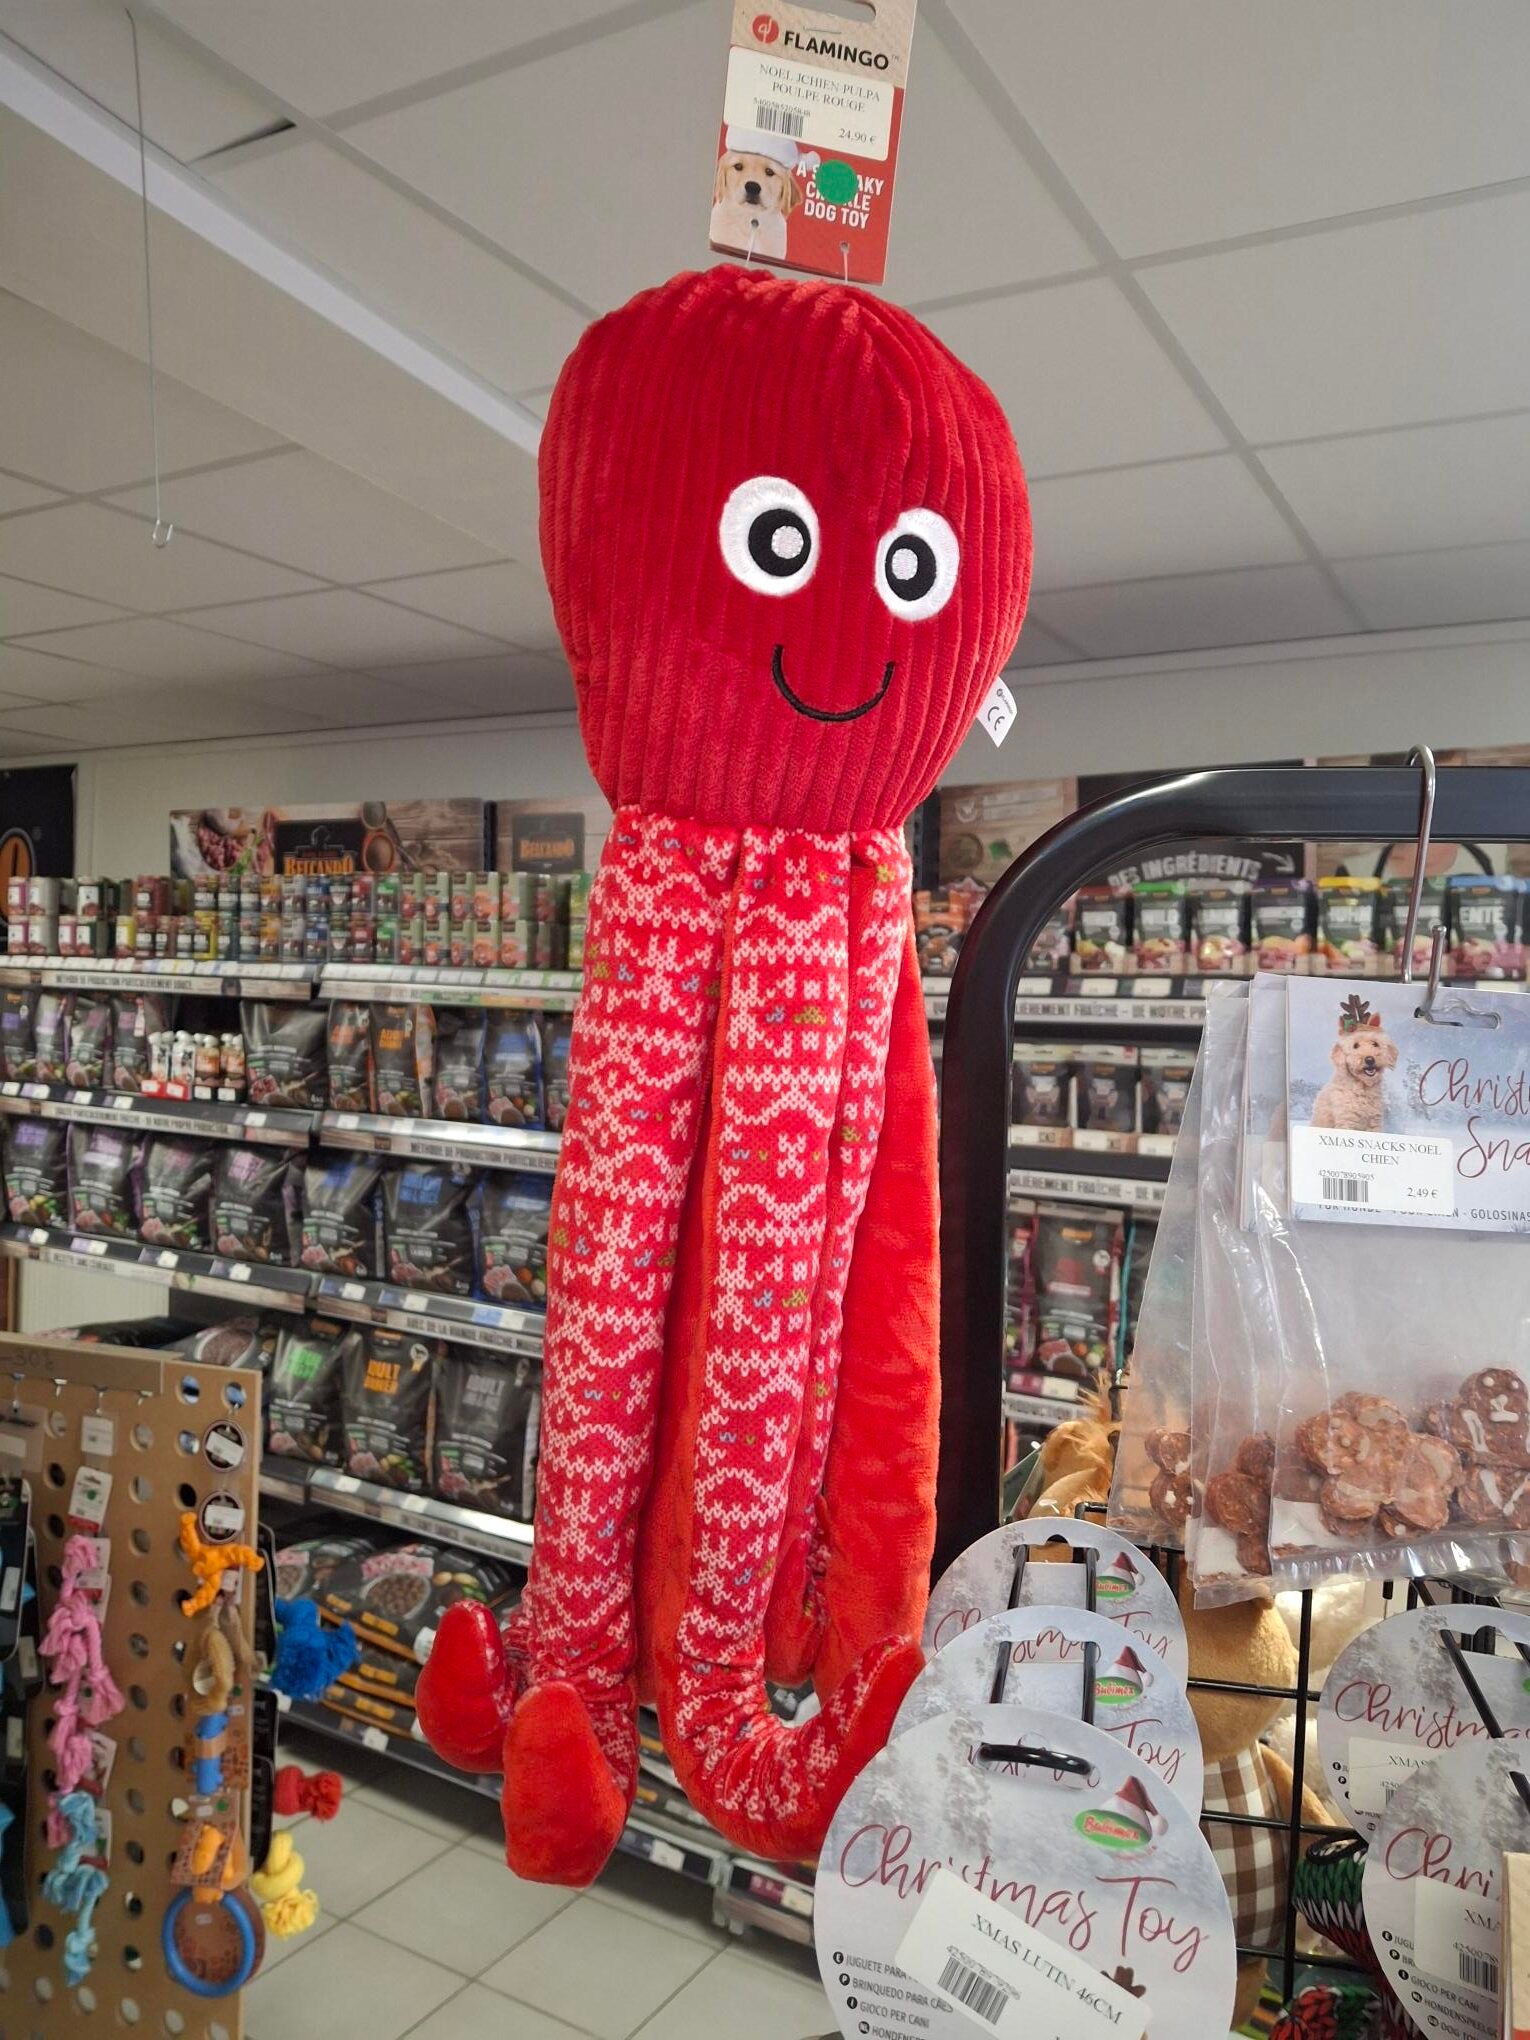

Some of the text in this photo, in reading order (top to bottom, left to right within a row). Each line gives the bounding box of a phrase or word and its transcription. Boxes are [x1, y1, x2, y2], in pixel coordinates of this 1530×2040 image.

[784, 31, 889, 71] FLAMINGO
[760, 63, 793, 81] NOEL
[843, 84, 880, 102] PULPA
[772, 82, 865, 113] POULPE ROUGE
[796, 161, 807, 177] A
[804, 199, 869, 229] DOG TOY
[1141, 850, 1262, 881] INGRÉDIENTS
[1419, 1057, 1530, 1117] Christ
[1319, 1135, 1442, 1156] XMAS SNACKS NOEL
[1361, 1153, 1399, 1166] CHIEN
[1457, 1115, 1530, 1178] Sna
[1335, 1681, 1530, 1748] Christm
[1385, 1827, 1495, 1897] Chri
[1095, 1876, 1209, 1973] Toy
[846, 1955, 883, 1974] JUGUETE
[971, 1913, 1021, 1956] XMAS
[1022, 1948, 1077, 1992] LUTIN
[1076, 1986, 1123, 2026] 46CM
[852, 1978, 904, 1999] BRINQUEDO
[906, 1991, 929, 2007] PARA
[1410, 1975, 1480, 2013] GIOCO PER CANI
[860, 2001, 888, 2018] GIOCO
[890, 2009, 907, 2022] PER
[908, 2014, 930, 2029] CANI
